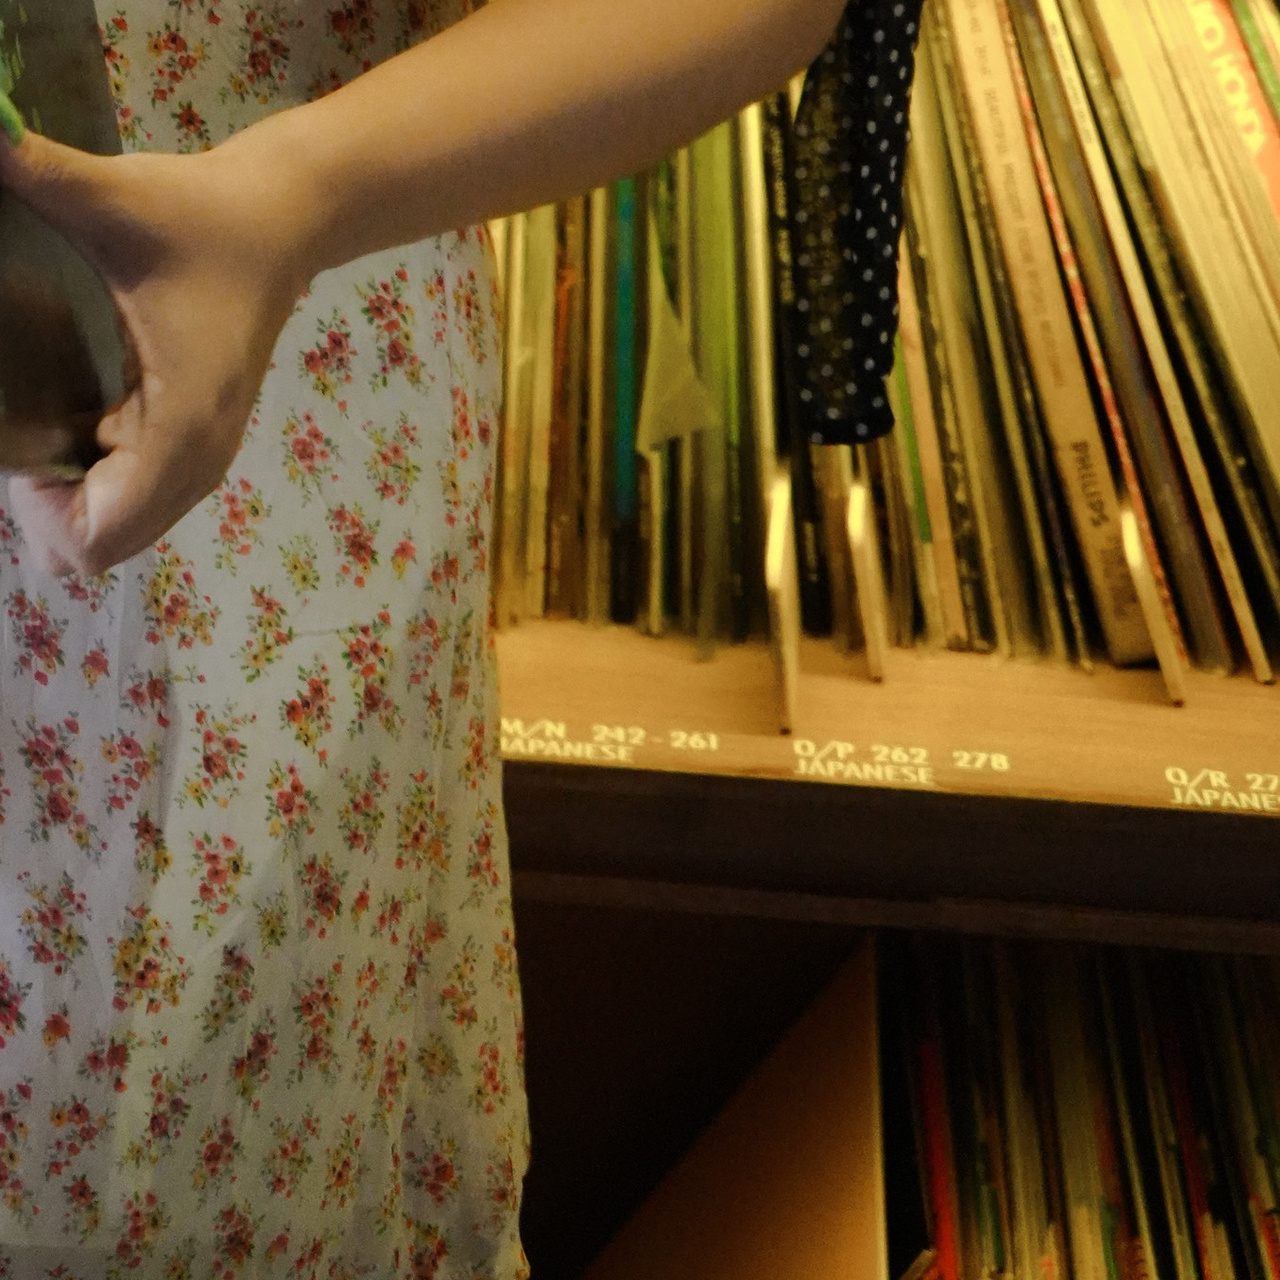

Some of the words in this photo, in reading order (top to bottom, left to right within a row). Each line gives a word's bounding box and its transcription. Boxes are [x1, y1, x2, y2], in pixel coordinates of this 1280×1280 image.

[1069, 440, 1111, 529] PHILIPS
[592, 724, 647, 747] 242
[670, 730, 719, 752] 261
[793, 739, 854, 762] O/P
[871, 744, 929, 765] 262
[952, 750, 1010, 771] 278
[794, 758, 935, 784] JAPANESE
[1169, 786, 1280, 811] JAPANE
